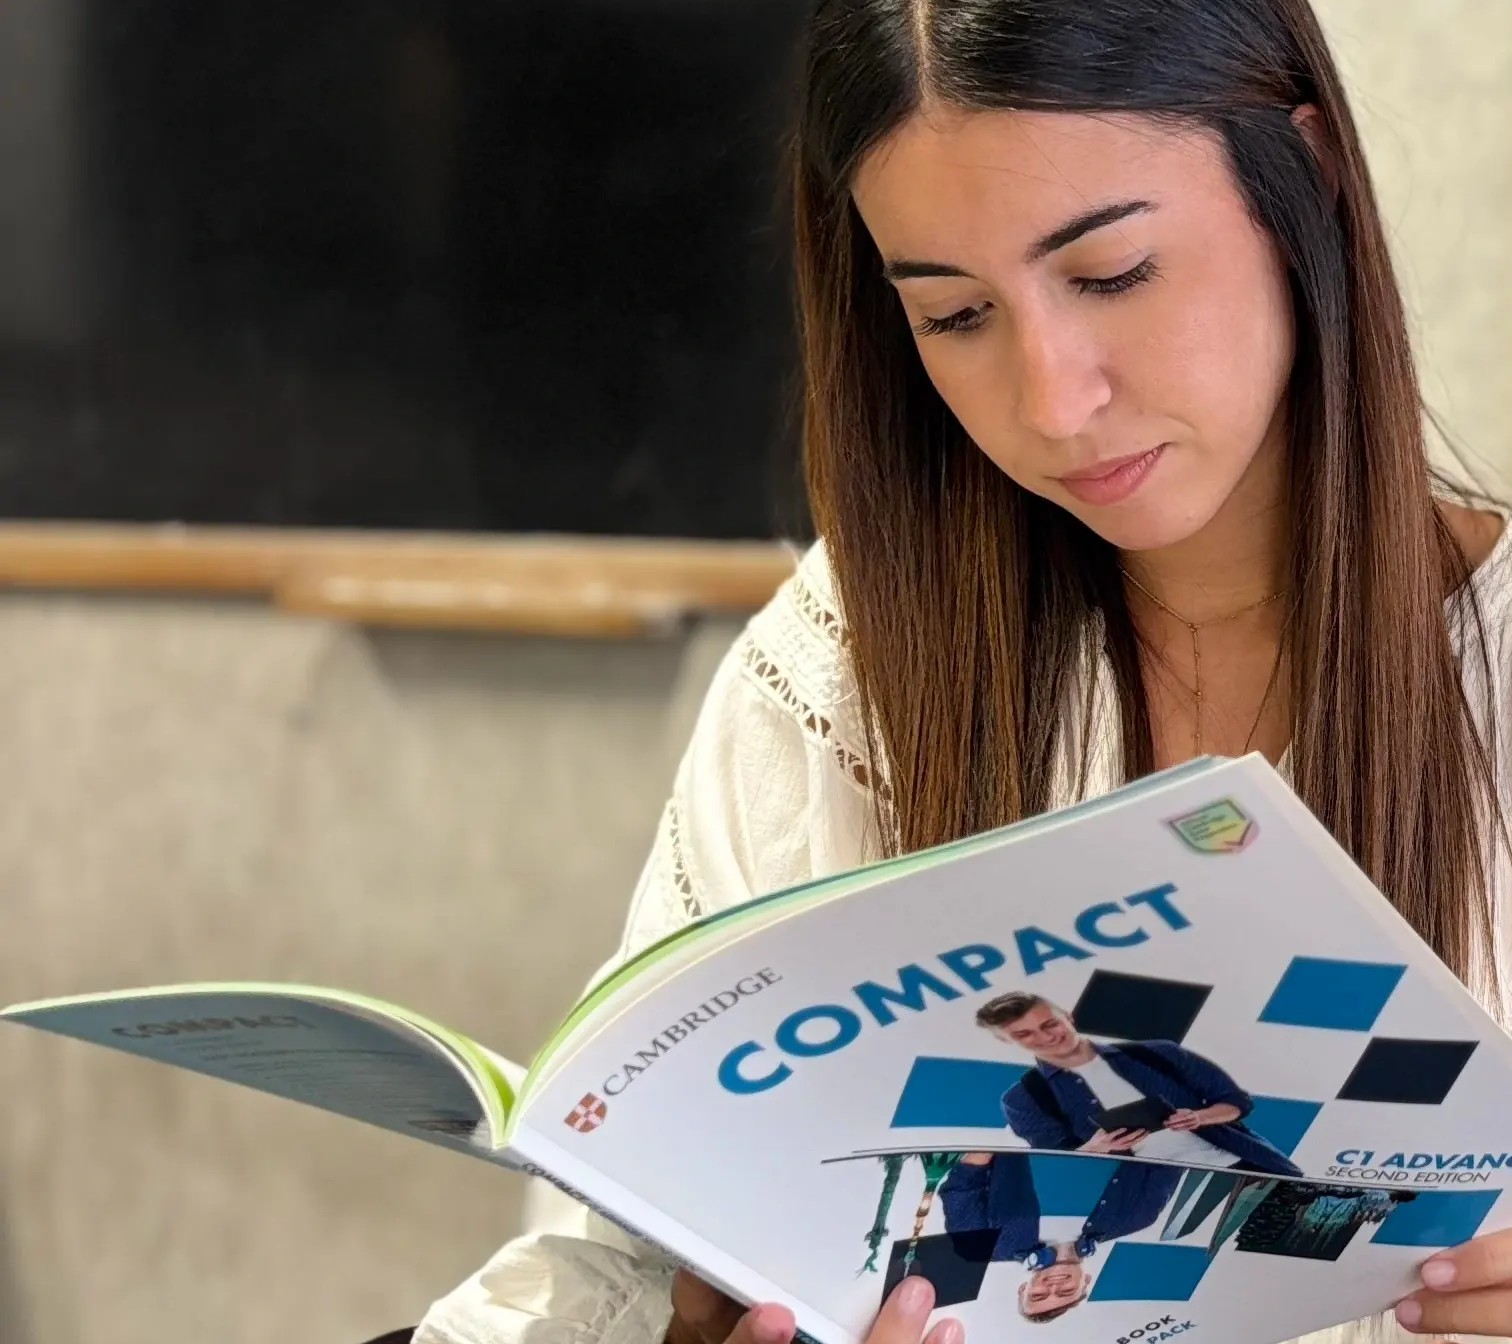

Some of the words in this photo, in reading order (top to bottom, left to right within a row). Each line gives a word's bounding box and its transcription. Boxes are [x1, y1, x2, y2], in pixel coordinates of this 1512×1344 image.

[716, 882, 1194, 1096] COMPACT
[602, 966, 784, 1100] CAMBRIDGE
[1325, 1165, 1409, 1183] SECOND
[1416, 1171, 1493, 1184] EDITION
[1335, 1148, 1375, 1166] C1
